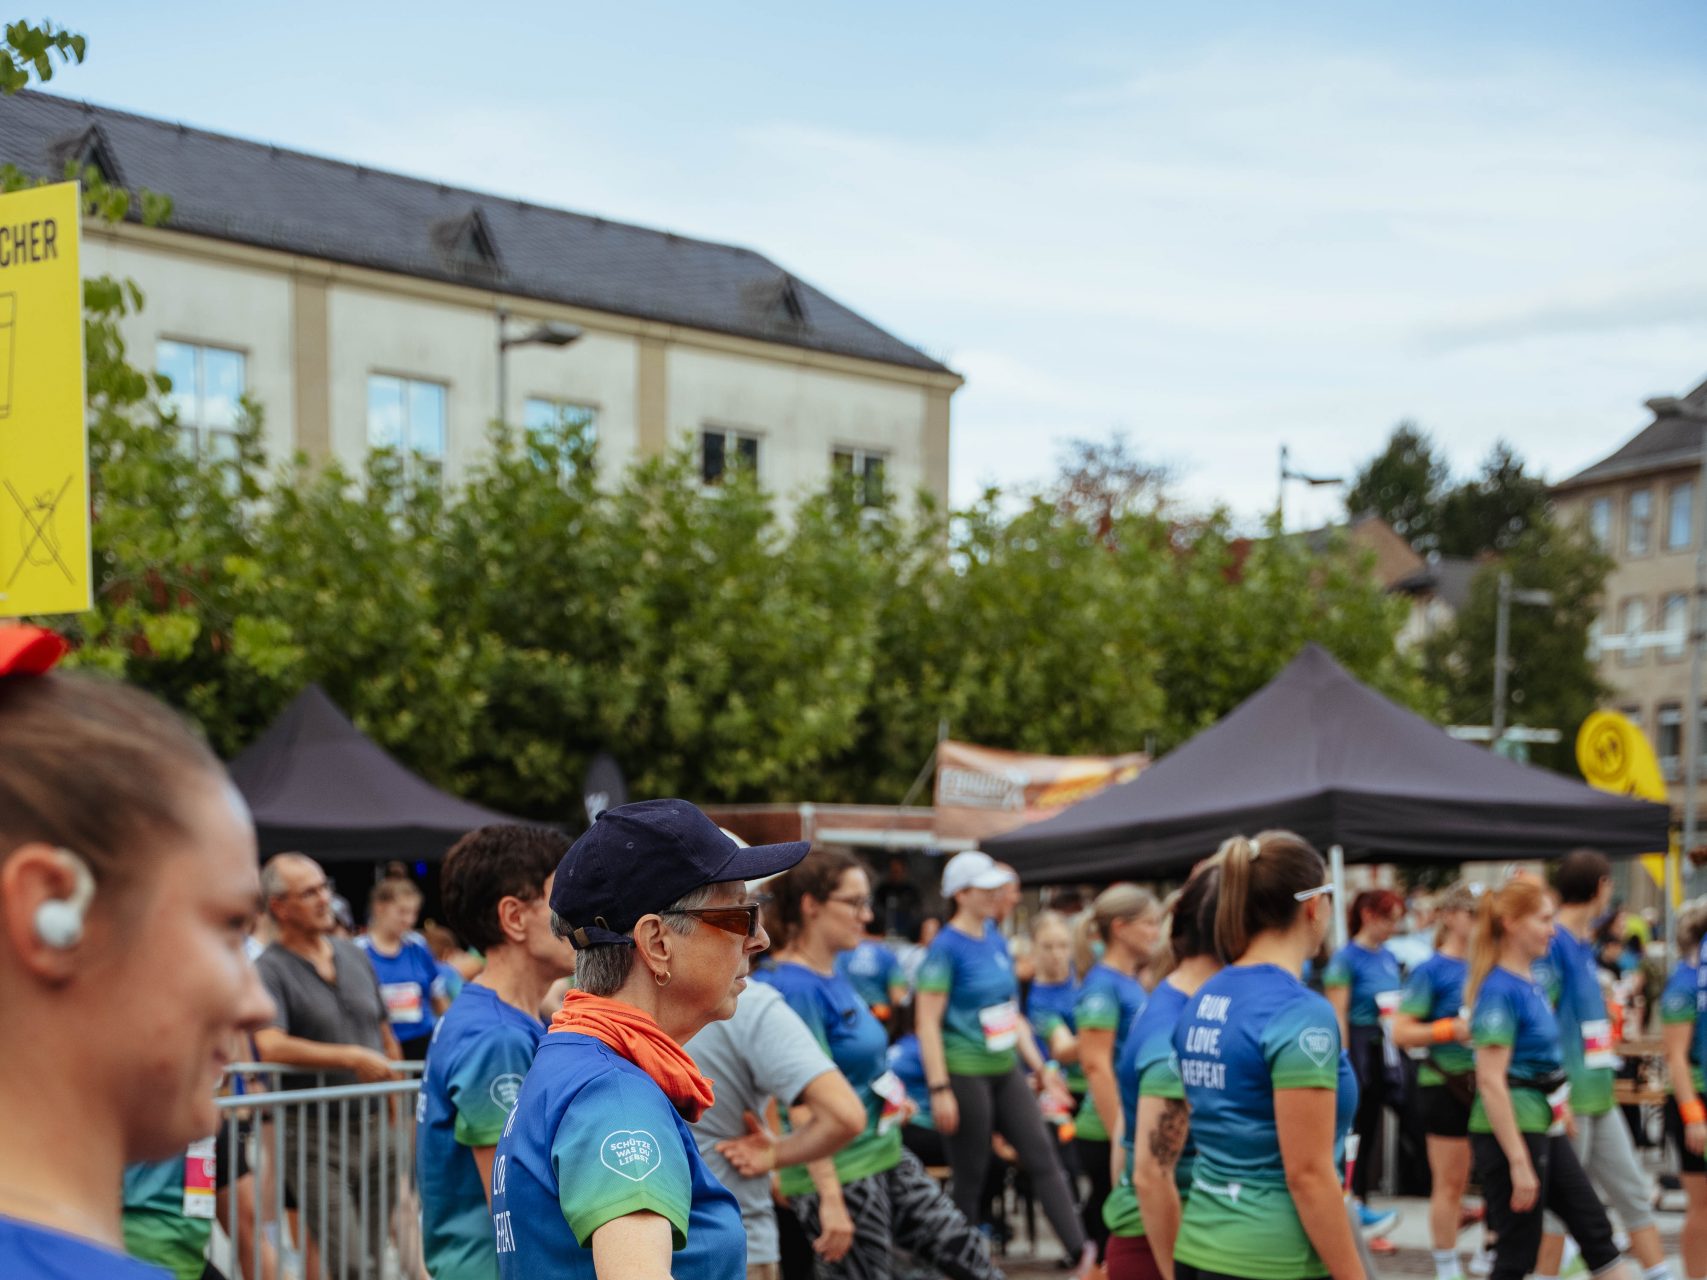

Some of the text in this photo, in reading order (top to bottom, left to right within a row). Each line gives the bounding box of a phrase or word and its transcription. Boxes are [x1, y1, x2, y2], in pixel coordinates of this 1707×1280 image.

[1181, 1059, 1227, 1091] REPEAT
[616, 1146, 650, 1158] WAS DU
